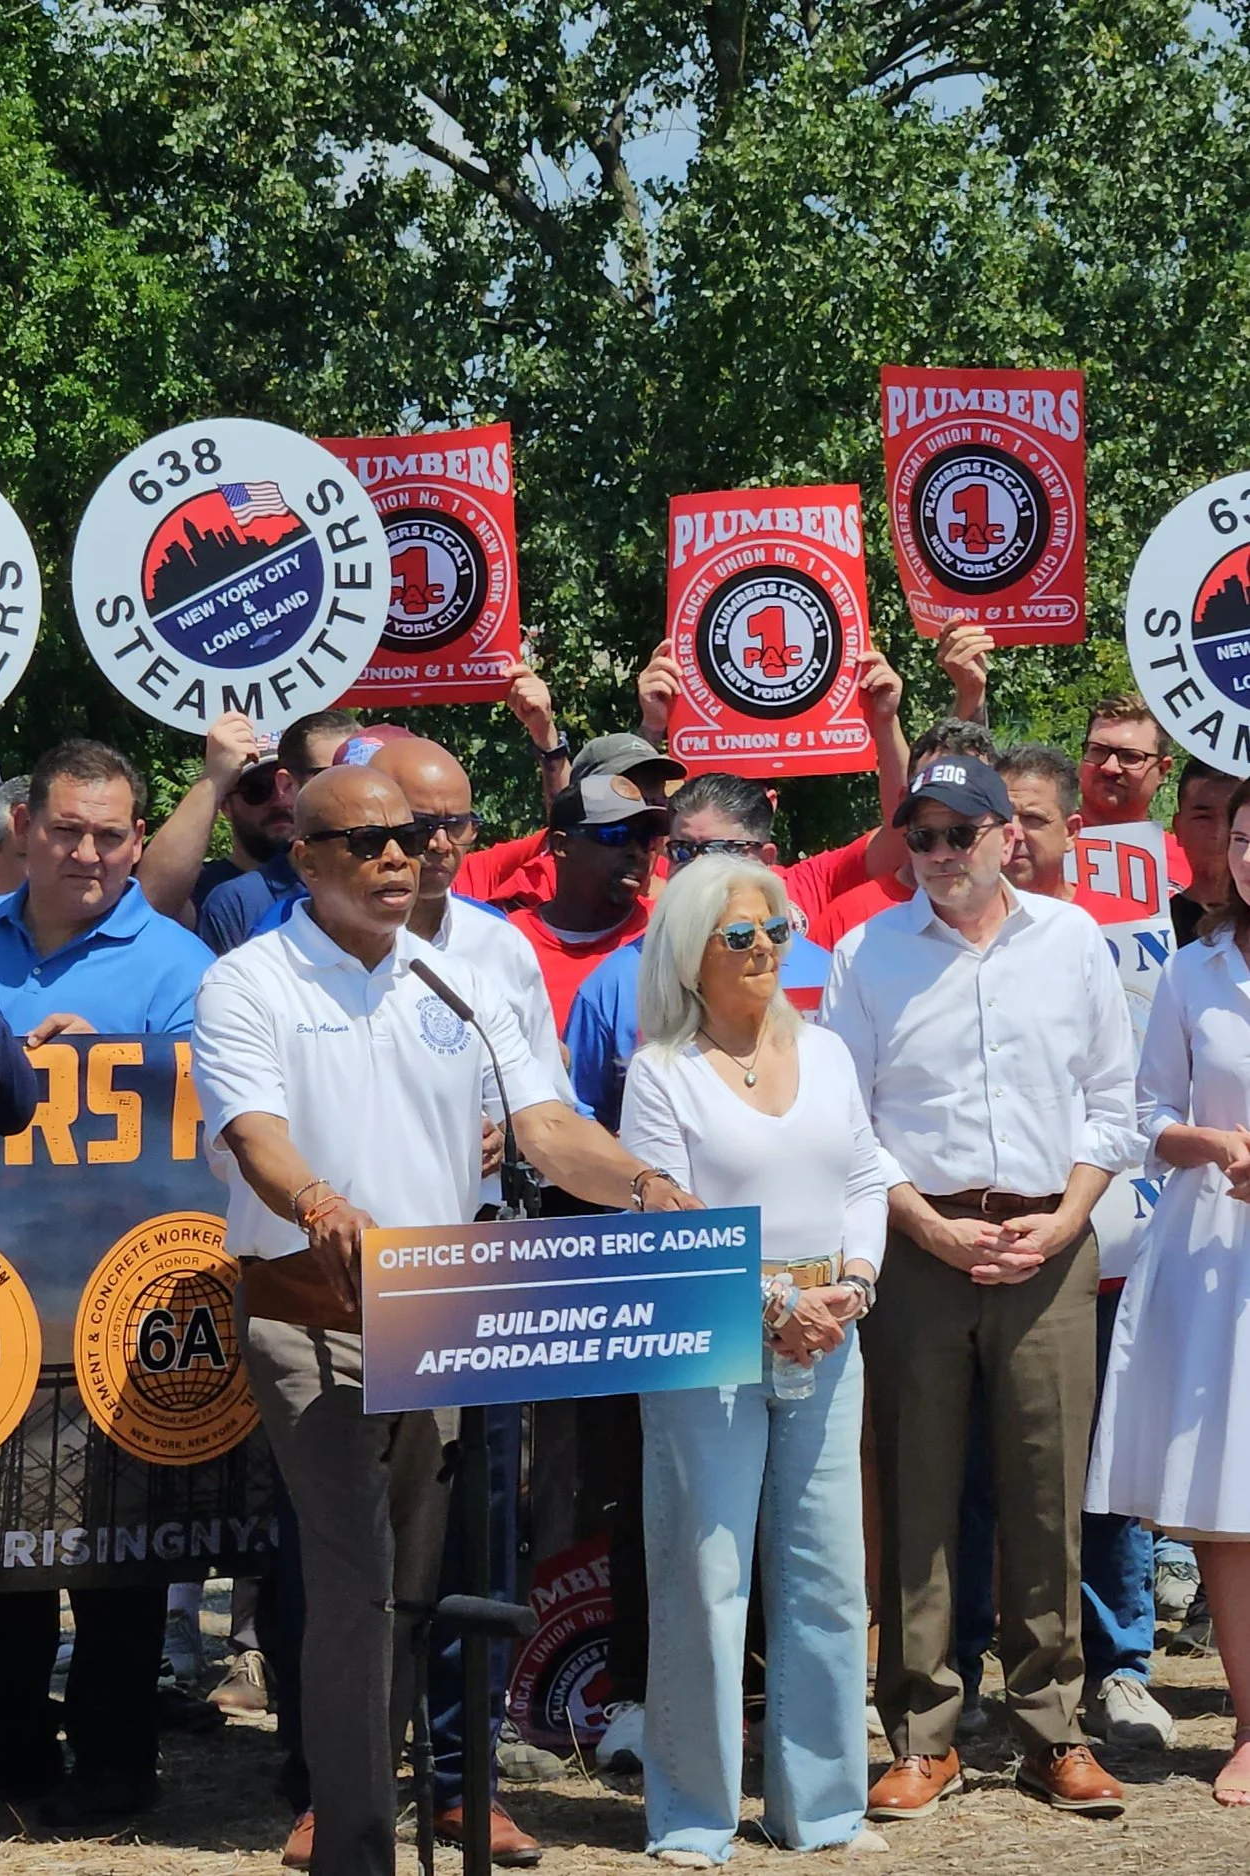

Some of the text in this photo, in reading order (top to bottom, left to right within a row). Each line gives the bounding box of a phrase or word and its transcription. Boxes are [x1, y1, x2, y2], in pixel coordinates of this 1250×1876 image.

[886, 385, 1080, 442] PLUMBERS
[925, 427, 972, 453] UNION
[1013, 439, 1022, 453] 1
[129, 438, 222, 506] 638
[338, 442, 510, 495] UMBERS
[899, 452, 926, 497] LOCAL
[925, 462, 982, 518] PLUMBERS
[984, 462, 1031, 510] LOCAL
[1038, 464, 1064, 499] NEW
[424, 525, 467, 568] LOCAL
[476, 520, 500, 555] NEW
[673, 504, 861, 569] PLUMBERS
[899, 502, 932, 587] PLUMBERS
[948, 522, 1006, 545] PAC
[1051, 506, 1068, 549] YORK
[714, 547, 766, 577] UNION
[807, 557, 816, 572] 1
[929, 534, 1026, 575] NEW YORK CITY
[1030, 554, 1058, 587] CITY
[96, 478, 372, 720] STEAMFITTERS
[177, 553, 302, 631] NEW YORK CITY
[488, 560, 504, 605] YORK
[682, 578, 715, 626] LOCAL
[831, 582, 856, 618] NEW
[202, 590, 310, 656] LONG ISLAND
[243, 600, 257, 614] &
[393, 621, 437, 635] YORK
[437, 594, 465, 625] CITY
[472, 611, 496, 645] CITY
[714, 582, 778, 646] PLUMBERS
[779, 584, 827, 630] LOCAL
[985, 606, 1002, 620] &
[1021, 603, 1072, 618] VOTE
[743, 647, 803, 669] PAC
[843, 624, 860, 669] YORK
[358, 665, 418, 681] UNION
[424, 664, 441, 678] &
[679, 632, 724, 717] PLUMBERS
[720, 658, 824, 699] NEW YORK CITY
[827, 674, 852, 712] CITY
[715, 733, 779, 750] UNION
[785, 732, 801, 747] &
[821, 727, 864, 745] VOTE
[379, 1226, 747, 1270] OFFICE OF MAYOR ERIC ADAMS
[88, 1228, 224, 1421] CEMENT & CONCRETE WORKER
[112, 1256, 200, 1352] JUSTICE HONOR
[476, 1302, 655, 1339] BUILDING AN
[137, 1305, 228, 1373] 6A
[415, 1330, 713, 1375] AFFORDABLE FUTURE
[129, 1427, 150, 1444] NEW
[212, 1419, 239, 1440] YORK
[513, 1670, 537, 1718] LOCAL
[531, 1616, 577, 1665] UNION
[553, 1650, 599, 1721] PLUMBERS
